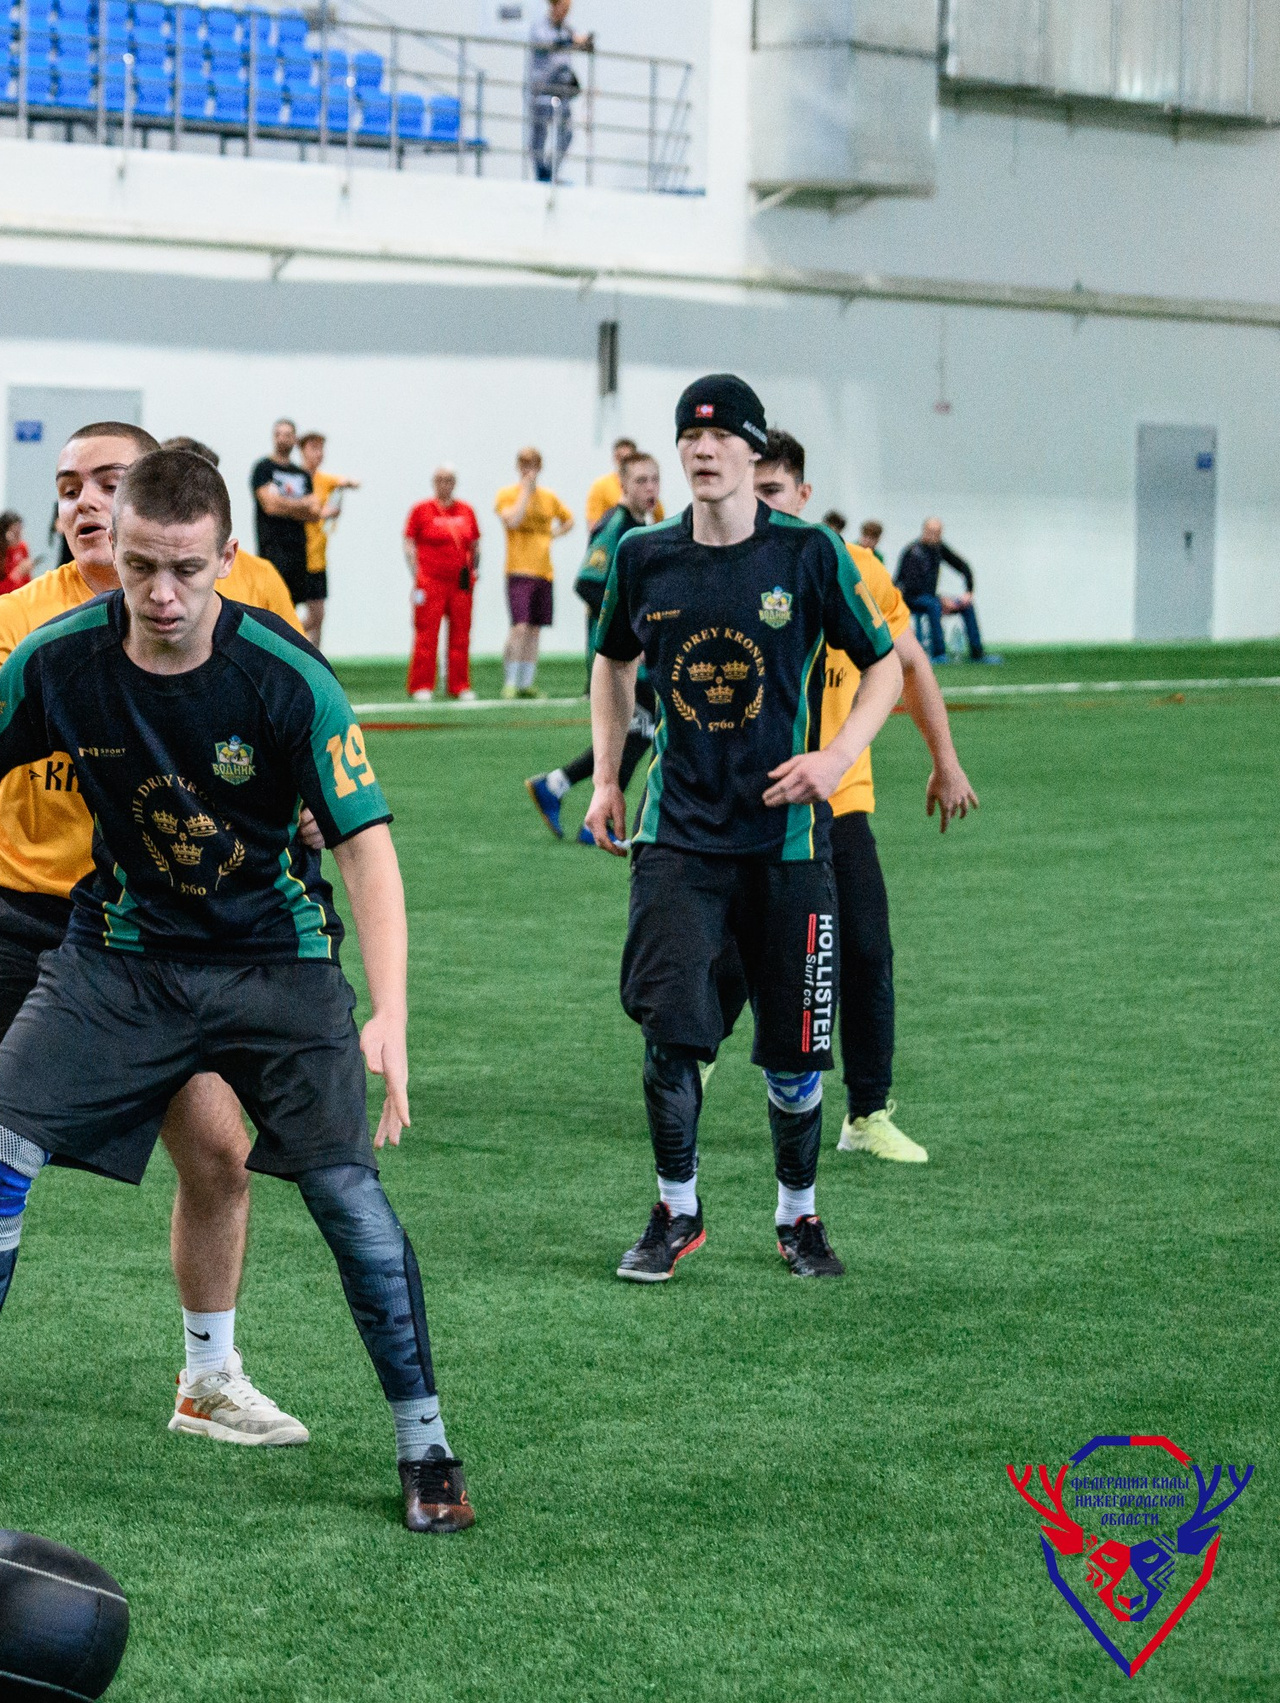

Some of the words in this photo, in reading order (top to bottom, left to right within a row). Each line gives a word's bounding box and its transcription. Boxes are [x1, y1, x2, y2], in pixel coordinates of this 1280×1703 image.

[671, 654, 685, 681] DIE
[682, 627, 719, 652] DREY
[724, 627, 765, 676] KRONEN
[211, 763, 256, 776] ВОДНИК
[326, 723, 375, 798] 19
[137, 774, 173, 798] DREY
[804, 953, 816, 986] Surf
[812, 914, 833, 1052] HOLLISTER
[803, 988, 812, 1010] co.
